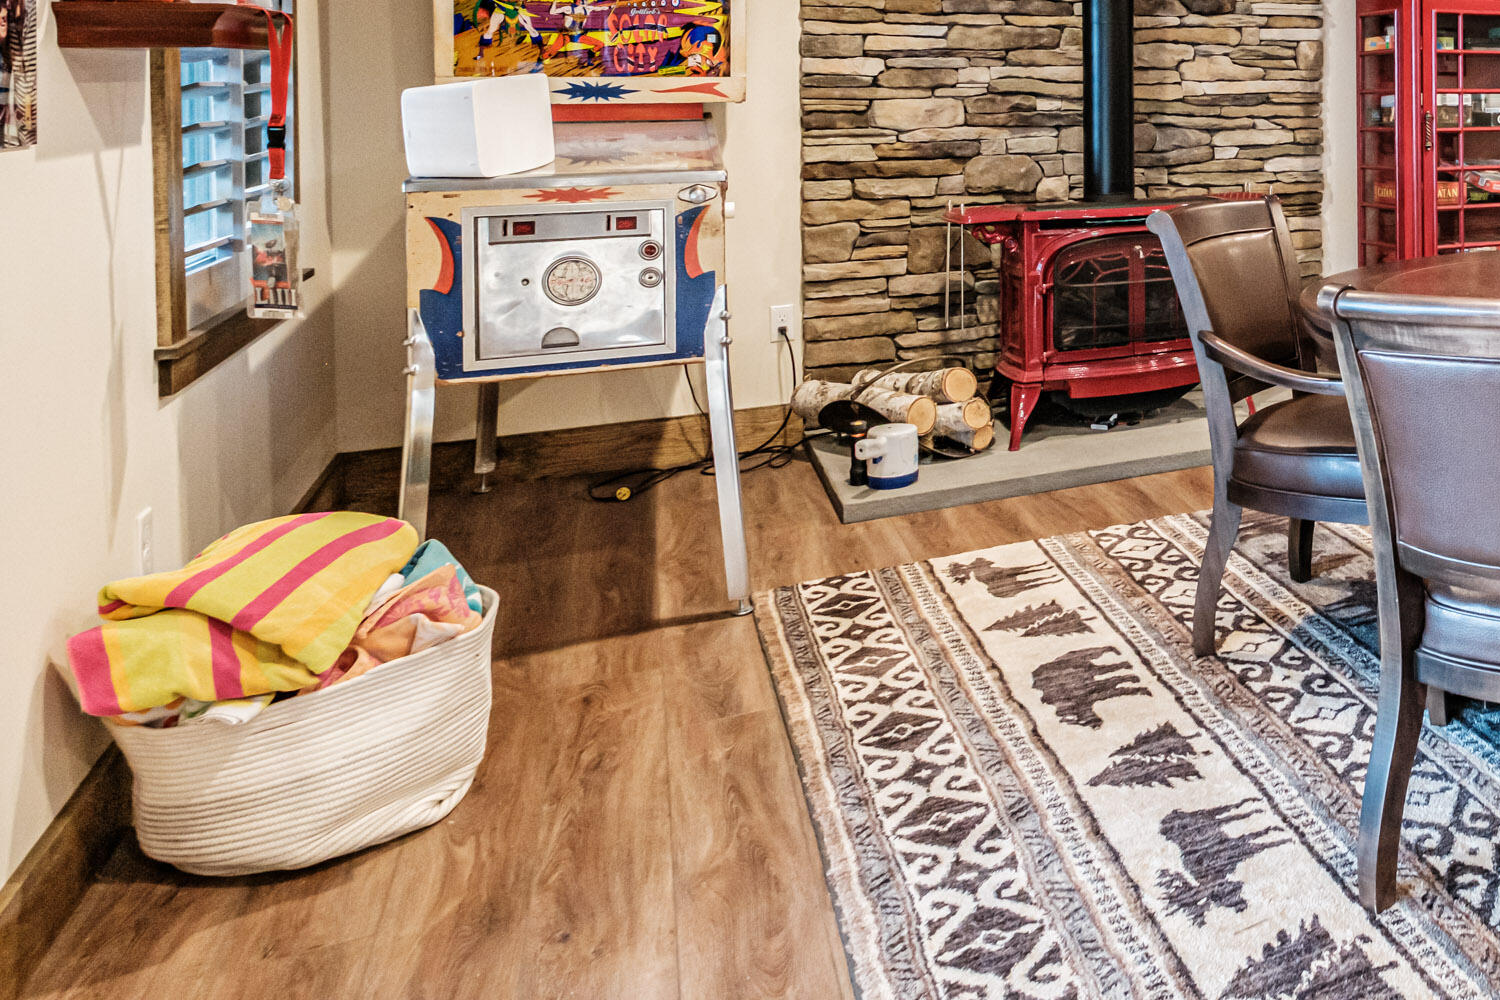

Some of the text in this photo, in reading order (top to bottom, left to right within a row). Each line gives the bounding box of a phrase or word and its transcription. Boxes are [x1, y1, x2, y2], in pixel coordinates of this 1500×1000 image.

[607, 13, 668, 43] SOLAR
[613, 43, 658, 73] CITY
[1437, 187, 1458, 199] ATAN
